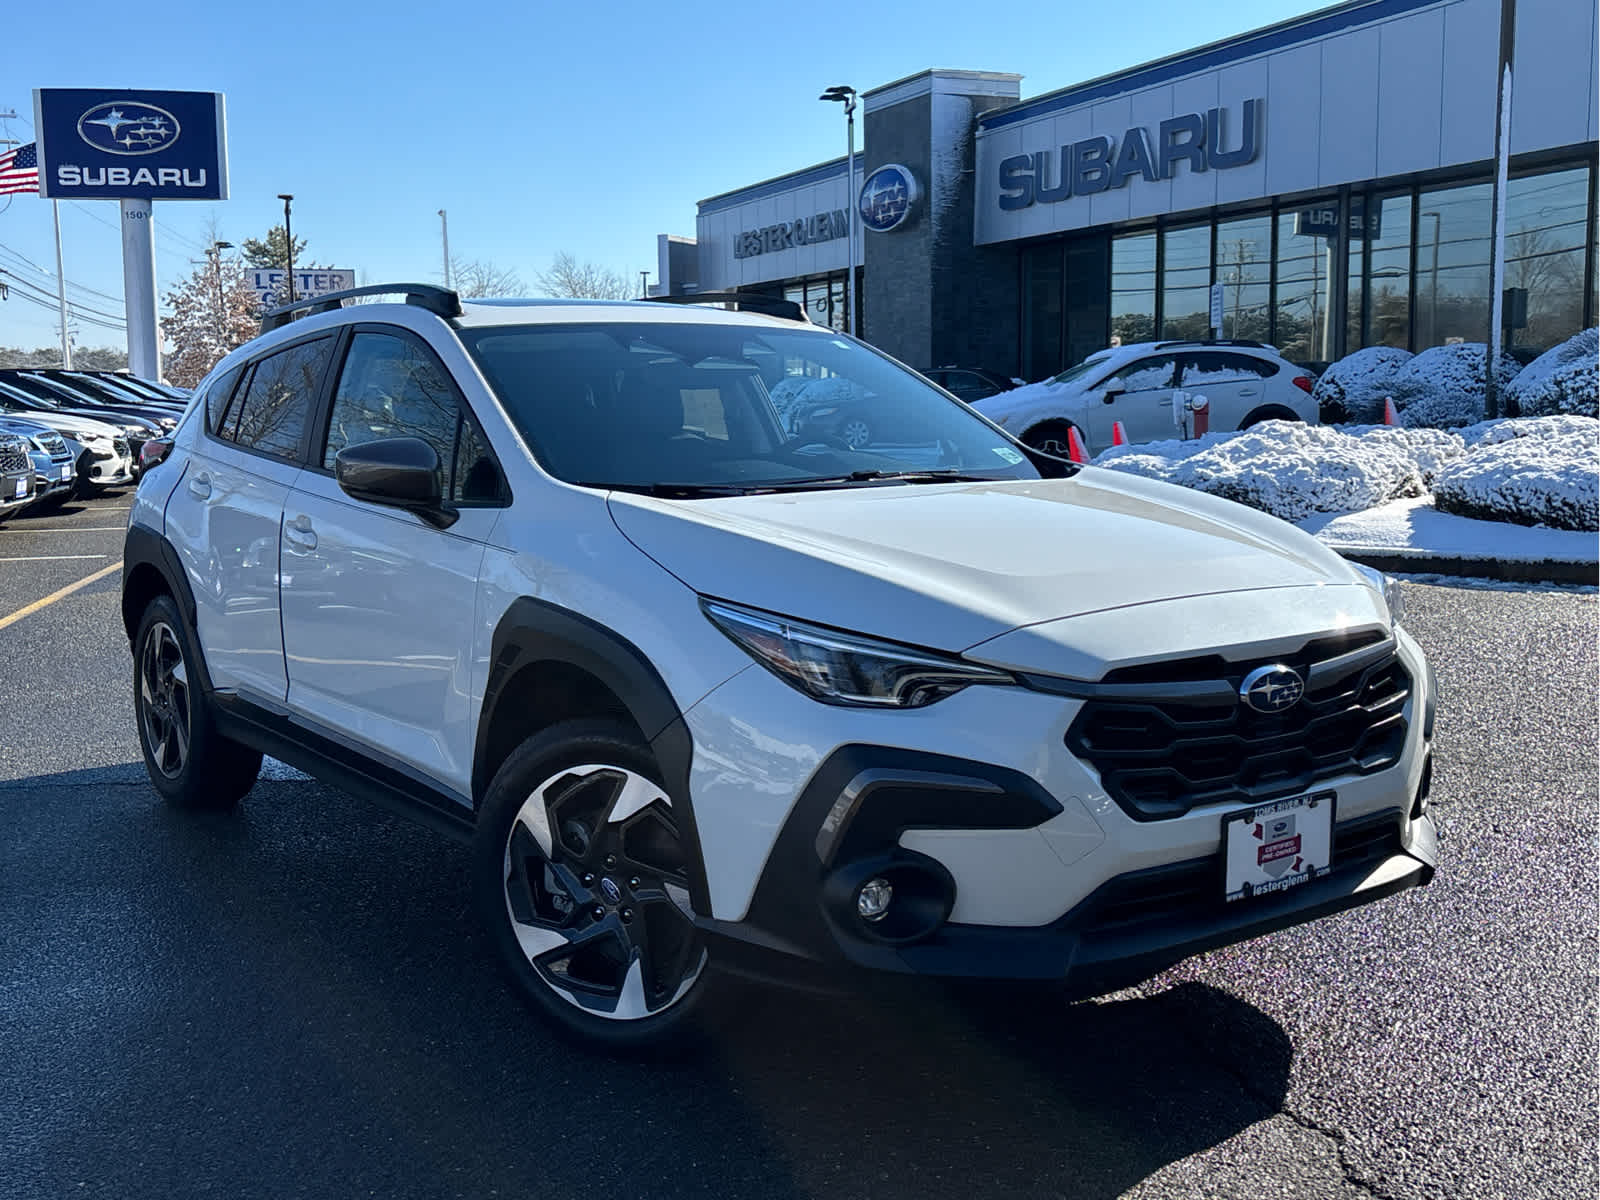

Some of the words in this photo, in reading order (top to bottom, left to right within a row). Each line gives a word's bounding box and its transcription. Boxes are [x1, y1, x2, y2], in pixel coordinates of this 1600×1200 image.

[998, 98, 1262, 211] SUBARU
[57, 166, 207, 187] SUBARU
[734, 221, 796, 259] LESTER
[794, 207, 851, 246] GLENN
[255, 273, 345, 290] LETER
